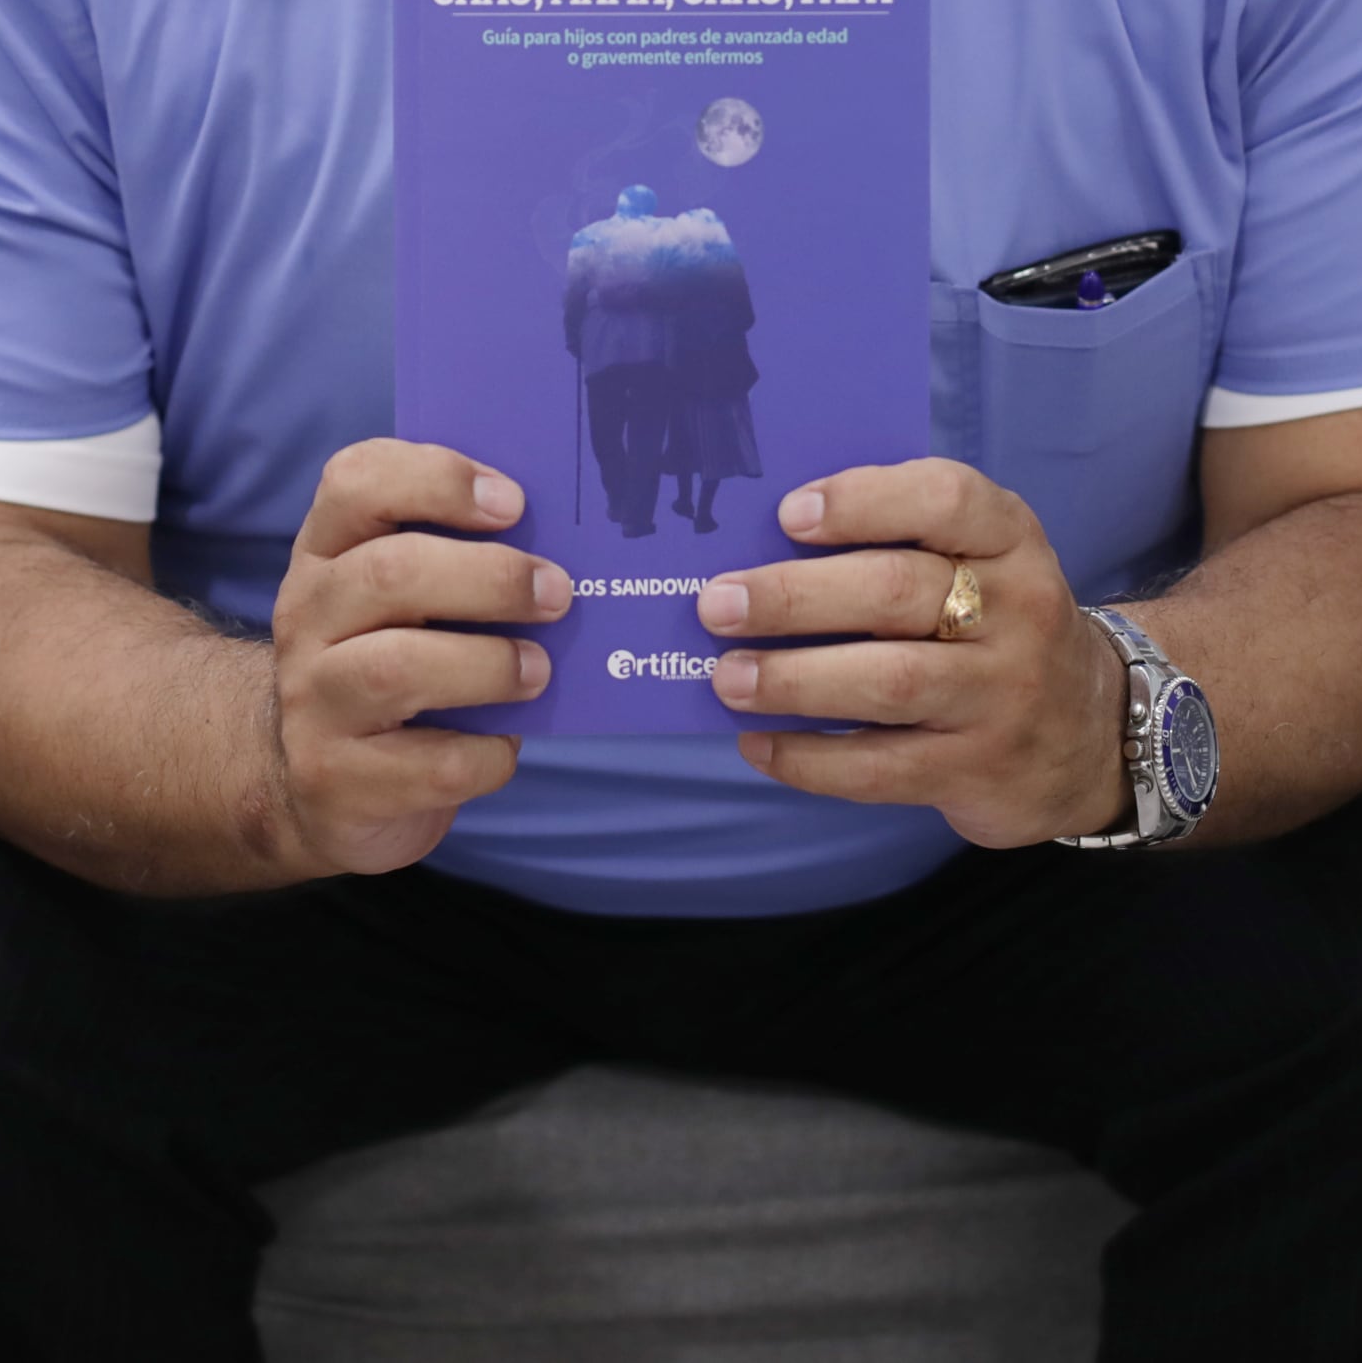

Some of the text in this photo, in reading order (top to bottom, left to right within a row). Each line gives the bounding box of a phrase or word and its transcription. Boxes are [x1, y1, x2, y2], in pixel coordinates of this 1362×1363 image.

[482, 27, 849, 49] Guía para hijos con padres de avanzada edad
[567, 48, 764, 69] o gravemente enfermos
